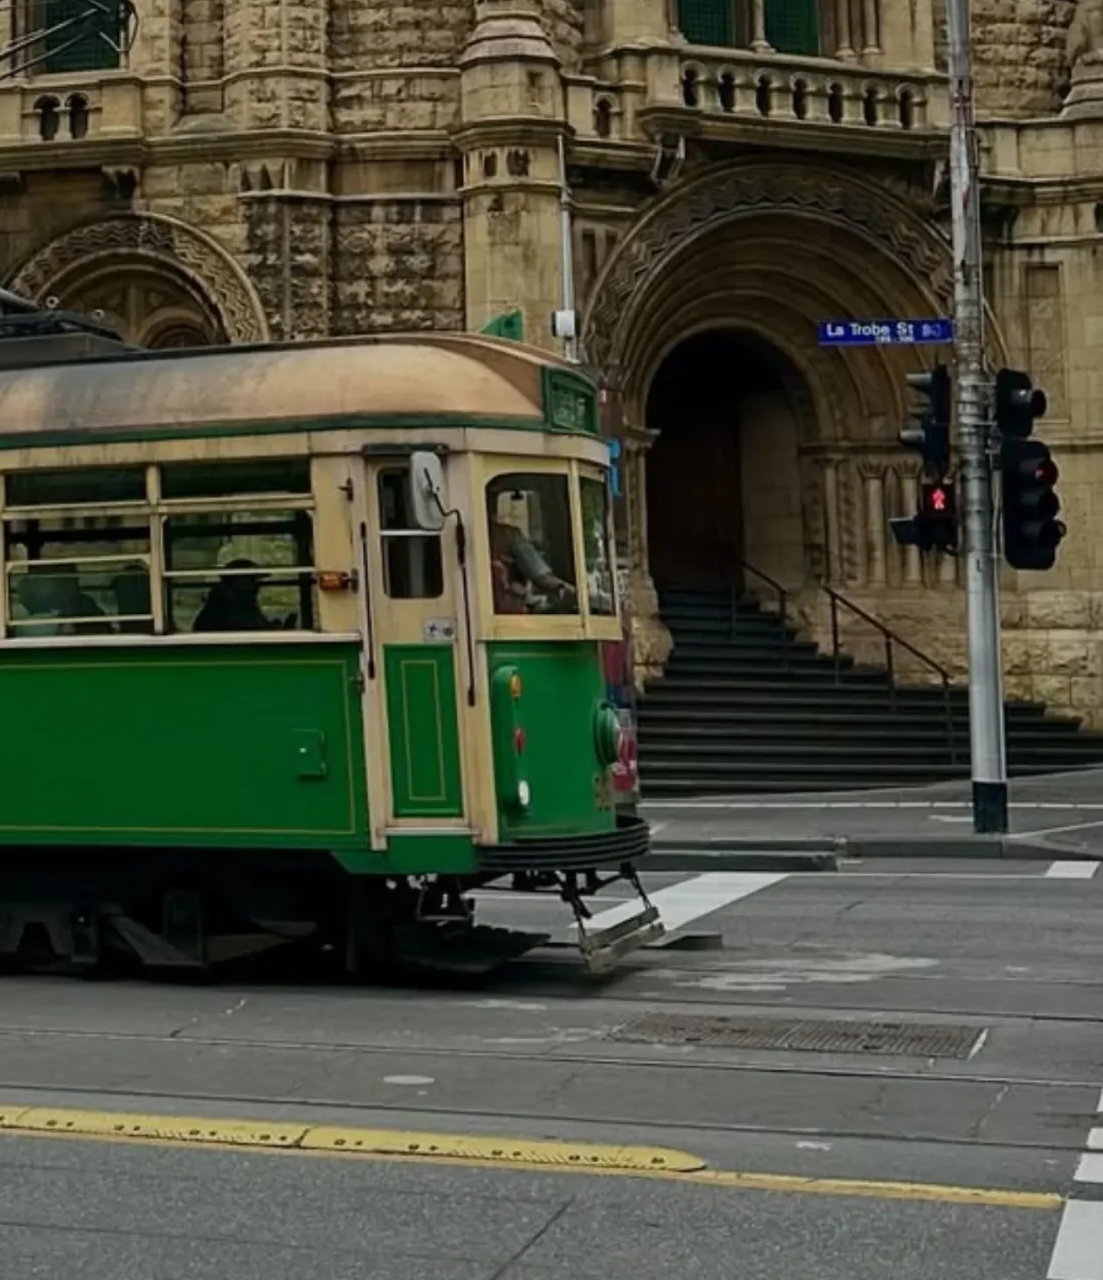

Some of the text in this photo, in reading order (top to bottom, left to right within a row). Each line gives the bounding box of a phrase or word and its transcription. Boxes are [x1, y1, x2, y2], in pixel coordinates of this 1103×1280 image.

[826, 323, 845, 337] La
[849, 322, 891, 337] Trobe
[897, 321, 913, 336] St
